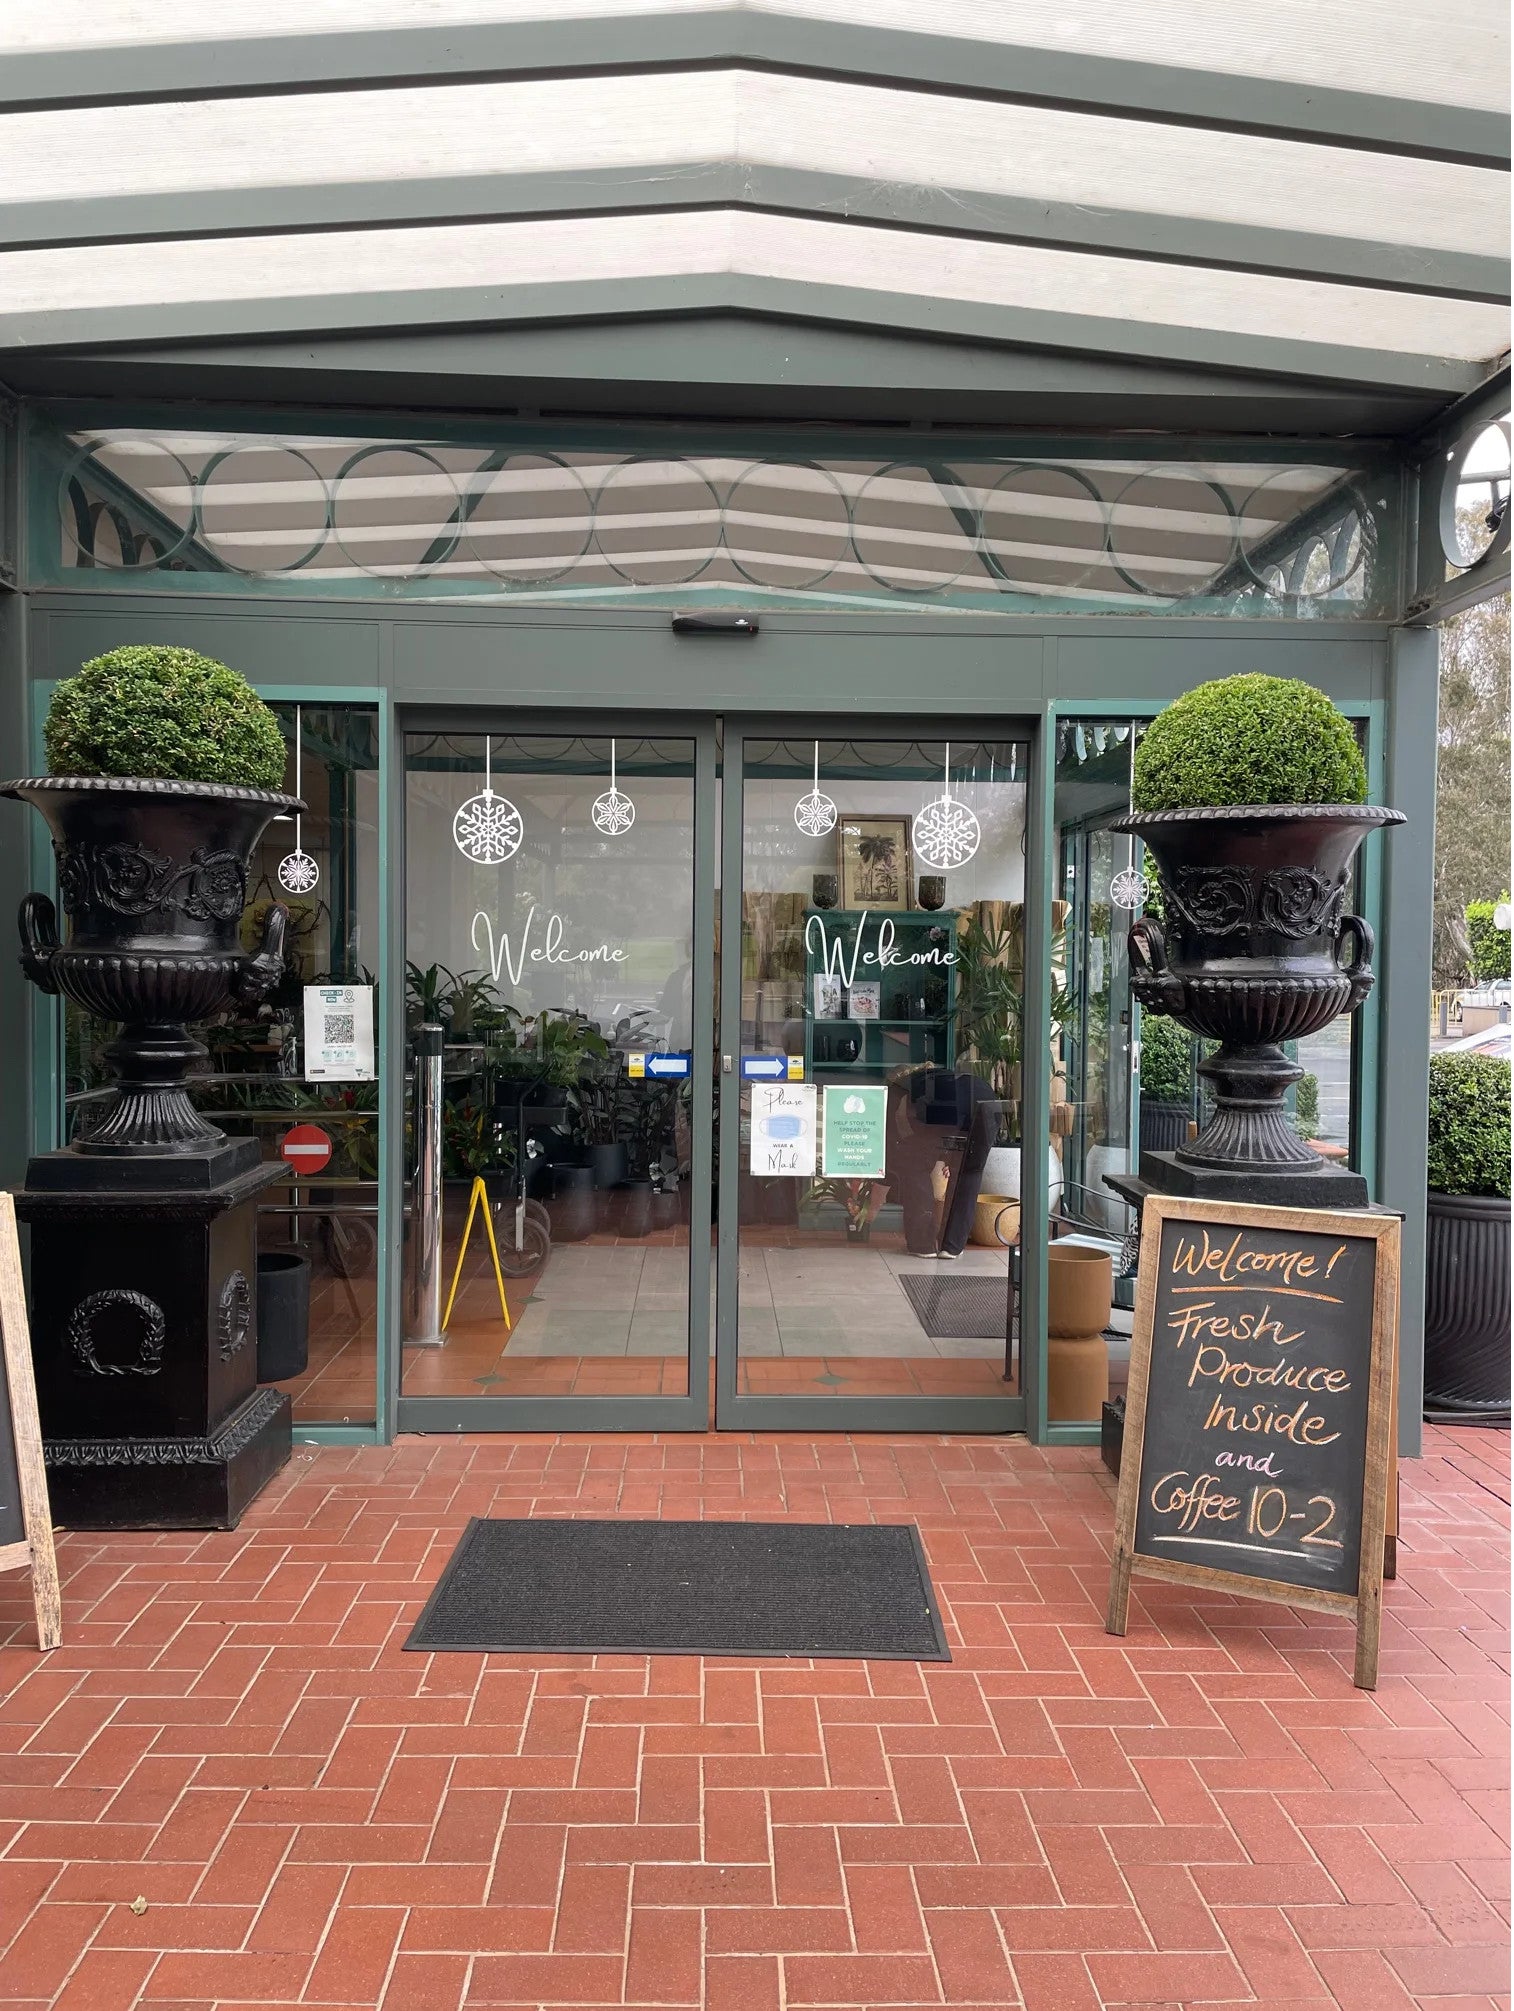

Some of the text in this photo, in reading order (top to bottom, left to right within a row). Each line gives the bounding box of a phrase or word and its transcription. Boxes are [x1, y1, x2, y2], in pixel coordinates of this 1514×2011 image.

[471, 906, 630, 987] Welcome
[805, 910, 960, 989] Welcome
[762, 1087, 803, 1113] Please
[768, 1149, 798, 1173] Mask
[1172, 1228, 1347, 1285] Welcome!
[1168, 1301, 1305, 1349] Fresh
[1187, 1342, 1351, 1393] Produce
[1203, 1393, 1341, 1446] Inside
[1214, 1448, 1284, 1478] and
[1151, 1471, 1344, 1548] Coffee 10-2
